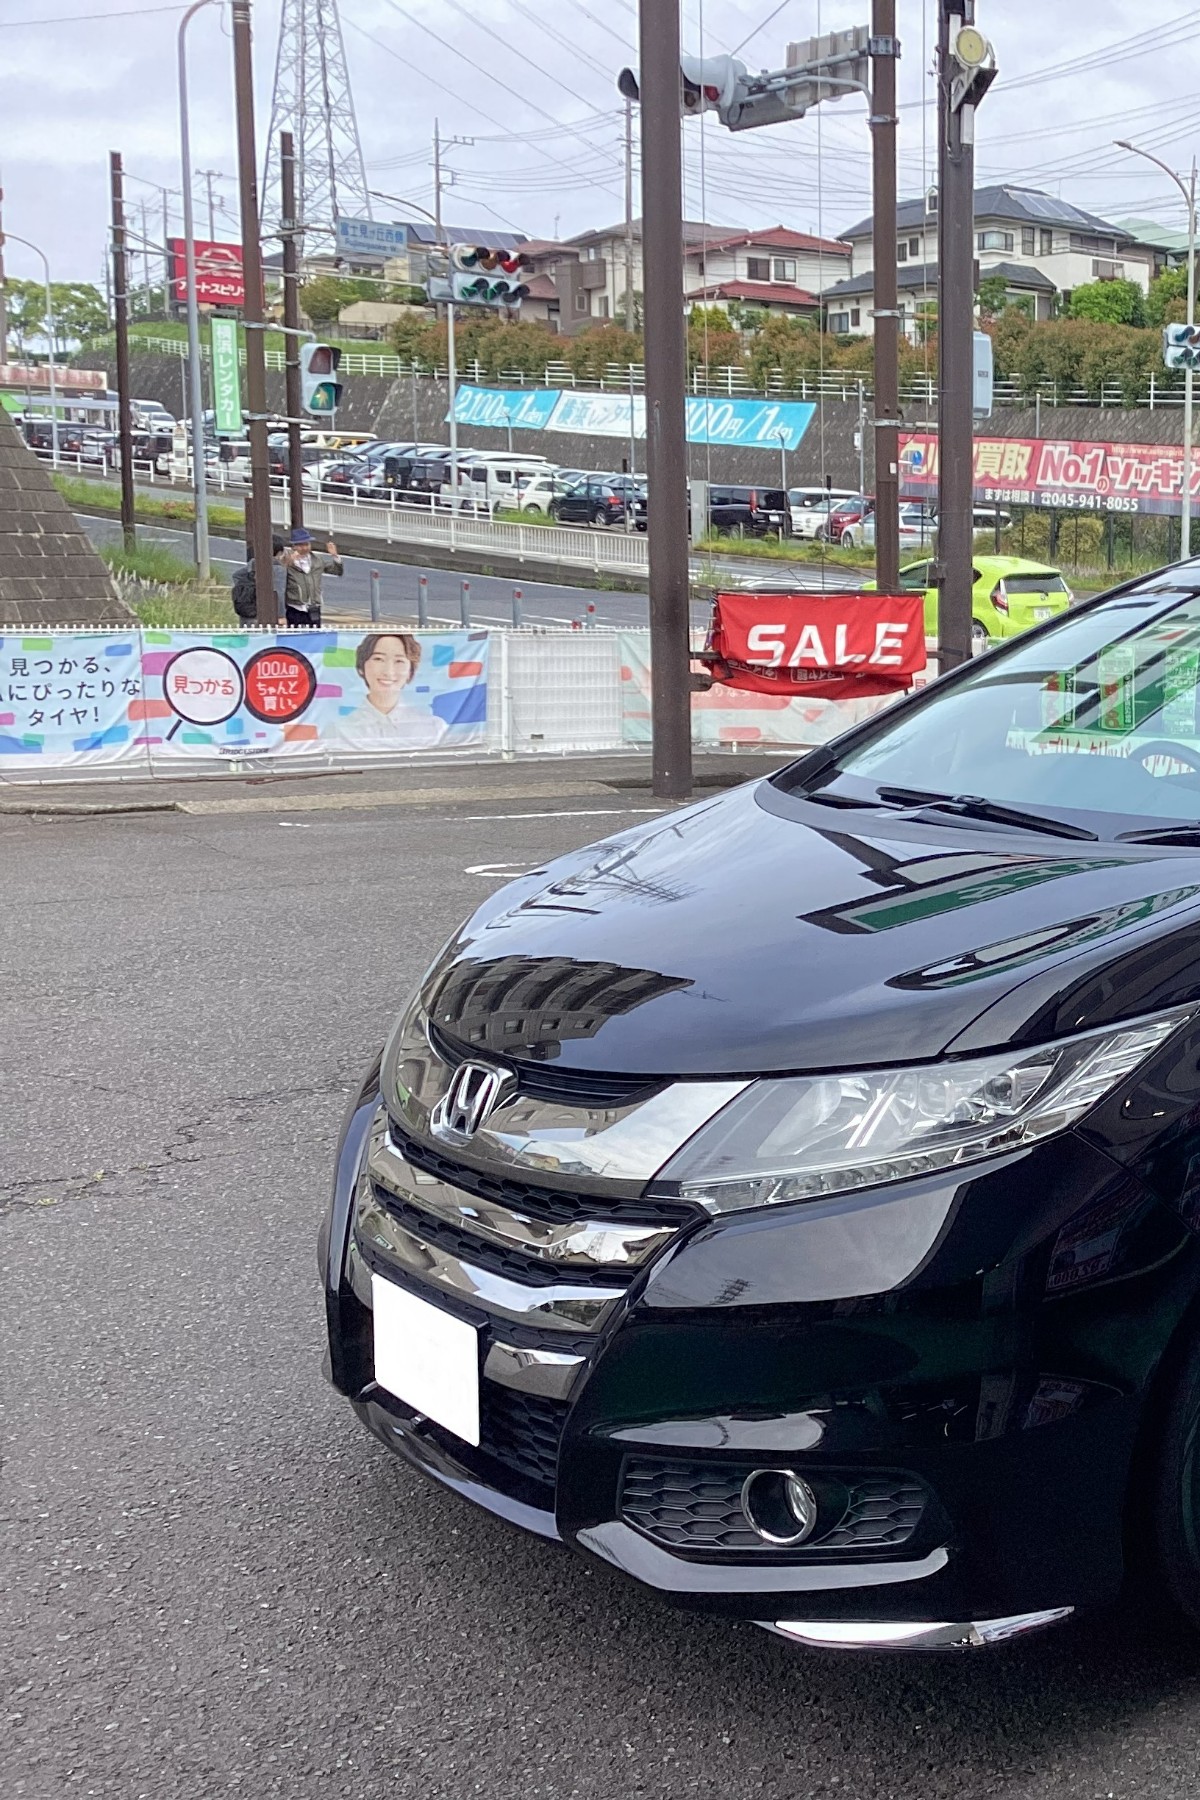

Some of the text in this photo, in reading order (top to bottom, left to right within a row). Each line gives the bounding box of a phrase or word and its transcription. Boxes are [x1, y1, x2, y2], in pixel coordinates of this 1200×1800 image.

[1051, 492, 1139, 511] 045-941-8055
[746, 623, 908, 668] SALE
[256, 661, 299, 677] 100人の
[0, 678, 141, 702] にぴったりな
[174, 675, 235, 696] 見つかる
[256, 681, 298, 696] ちゃんと
[28, 706, 100, 727] タイヤ!
